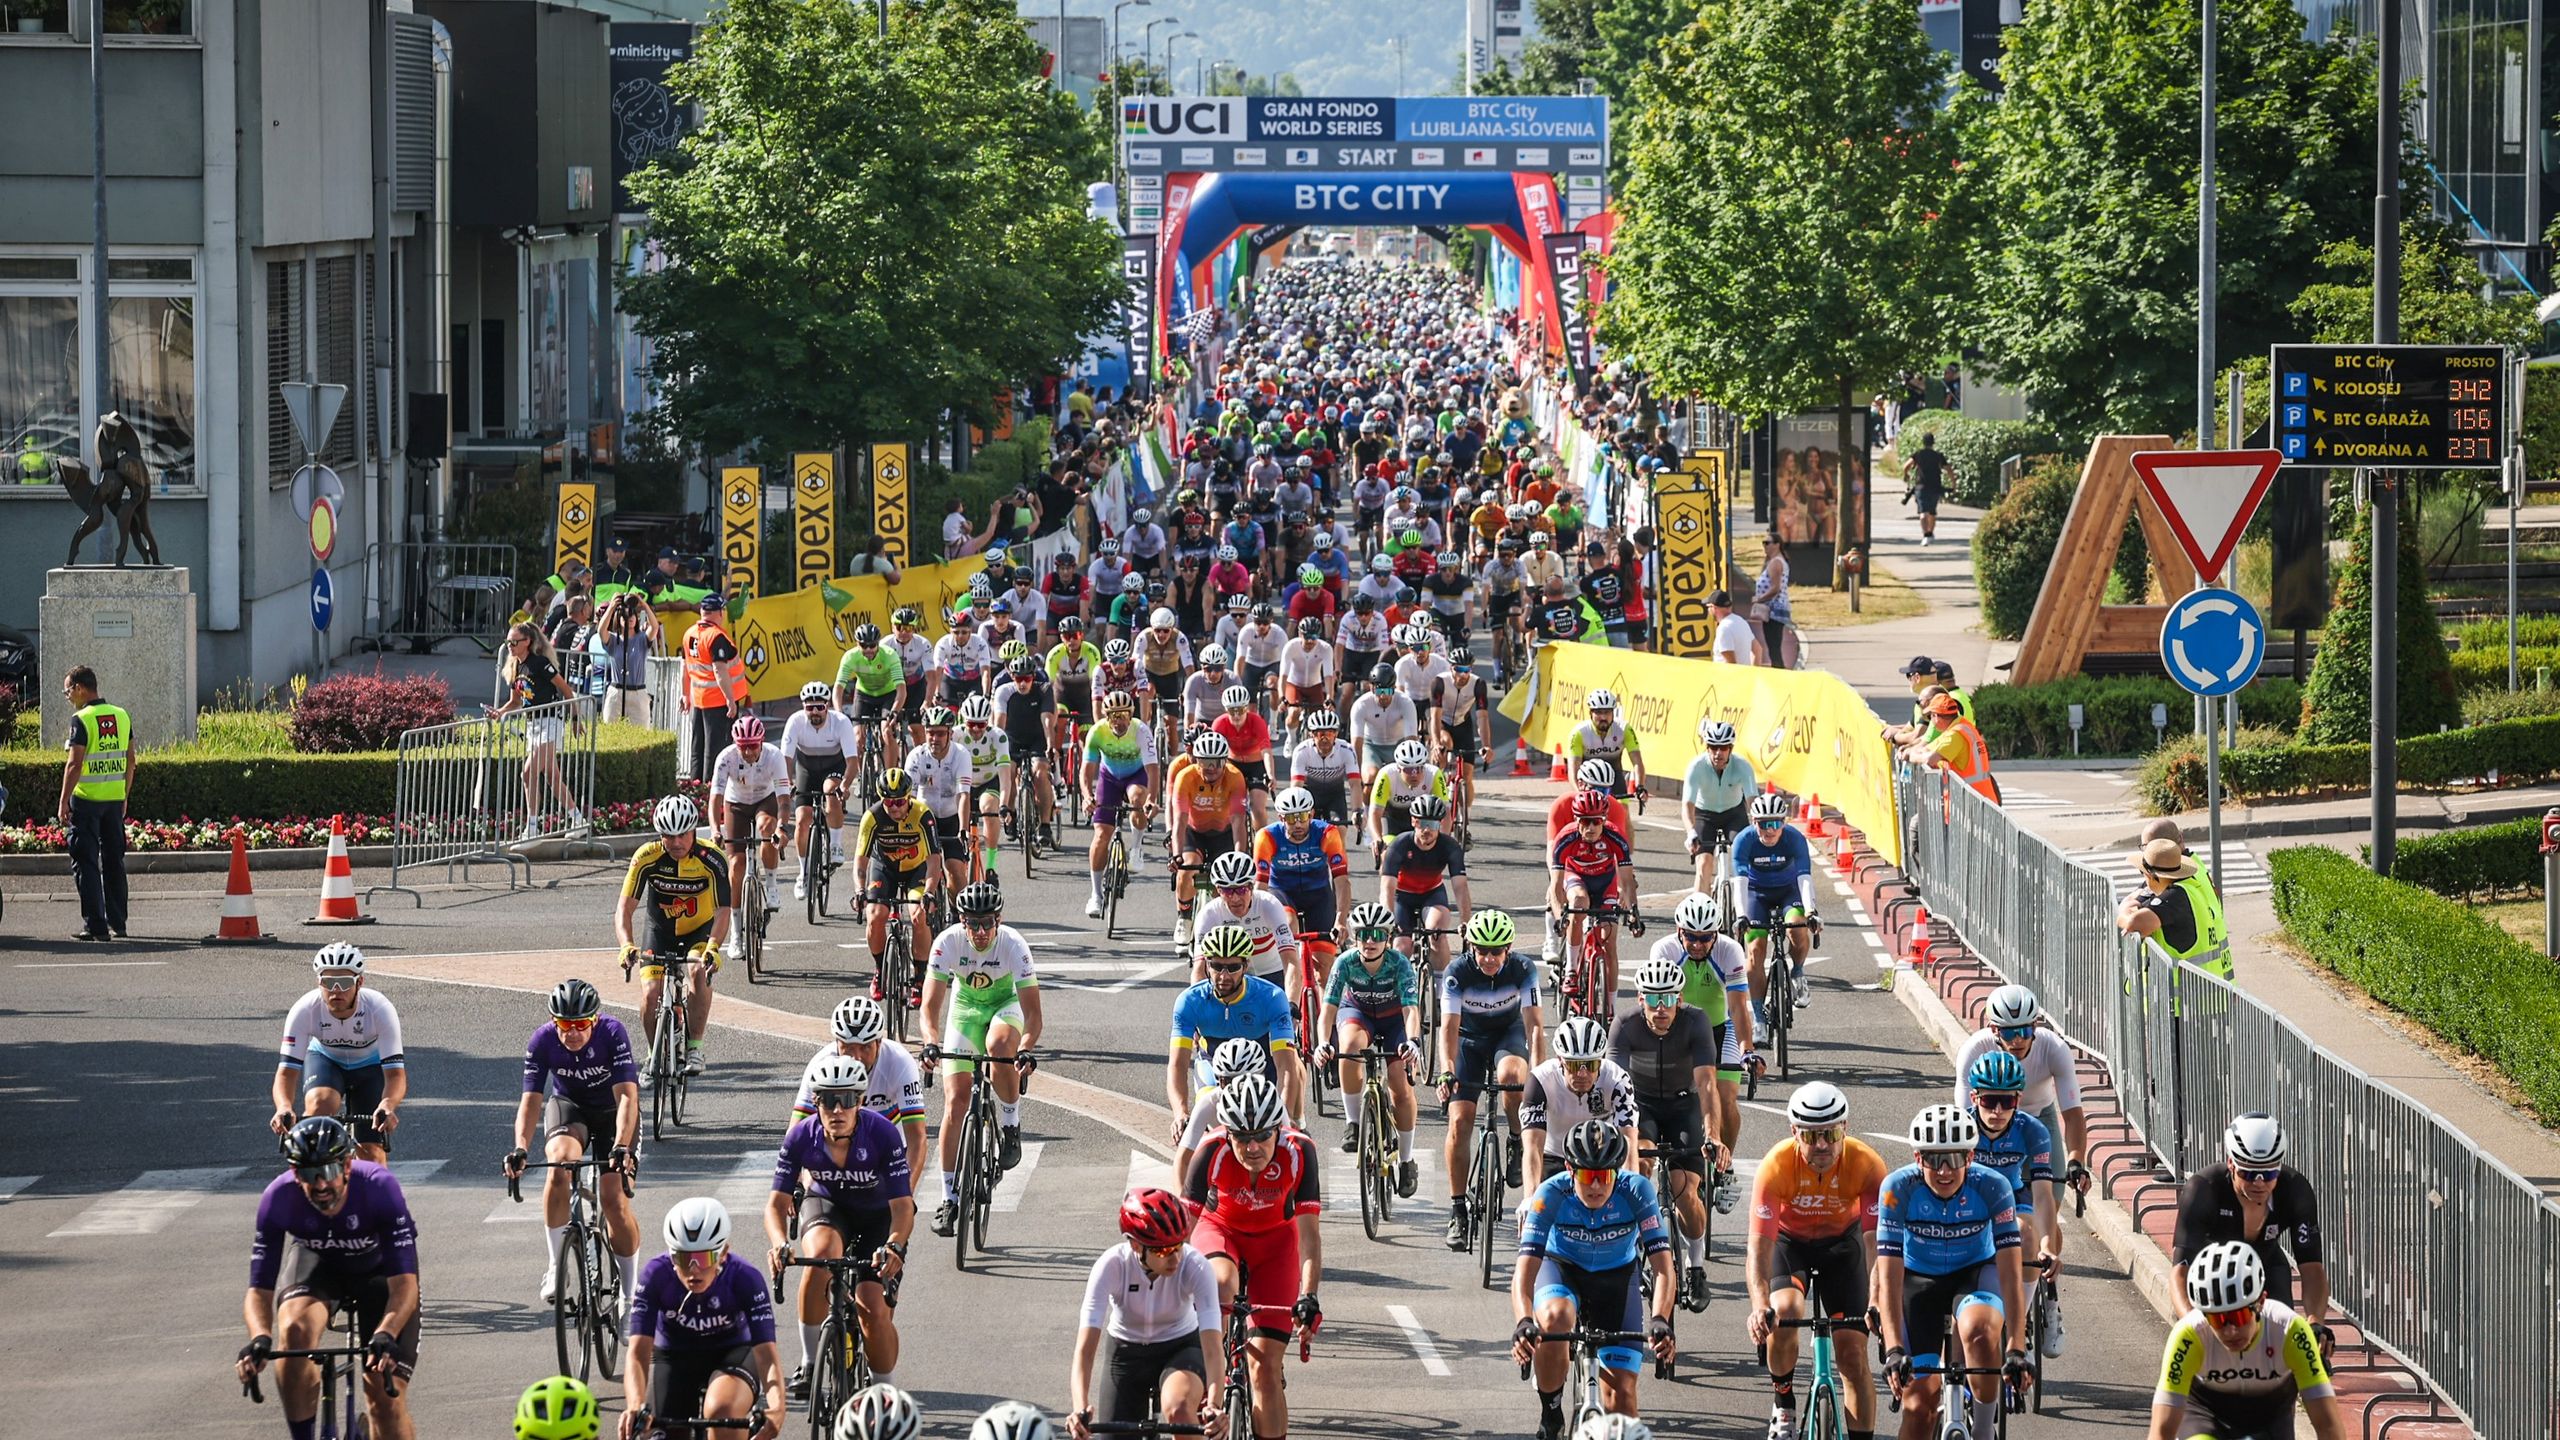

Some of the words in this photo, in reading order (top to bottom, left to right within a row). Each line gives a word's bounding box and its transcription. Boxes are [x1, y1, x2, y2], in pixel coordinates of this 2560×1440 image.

[617, 44, 670, 61] minicity
[1263, 103, 1313, 117] GRAN
[1318, 103, 1379, 117] FONDO
[1468, 103, 1500, 118] BTC
[1504, 103, 1538, 122] City
[1149, 103, 1229, 135] UCI
[1260, 121, 1322, 136] WORLD
[1326, 121, 1383, 136] SERIES
[1410, 121, 1596, 137] LJUBLJANA-SLOVENIA
[1338, 148, 1398, 166] START
[1294, 184, 1360, 210] BTC
[1371, 184, 1450, 210] CITY
[2334, 355, 2361, 368] BTC
[2366, 355, 2395, 370] City
[2445, 357, 2496, 368] PROSTO
[2334, 382, 2401, 396] KOLOSEJ
[2448, 379, 2491, 401] 342
[2333, 413, 2363, 426] BTC
[2365, 409, 2431, 426] GARAŽA
[2452, 408, 2491, 430] 156
[2333, 443, 2413, 457] DVORANA
[2416, 443, 2429, 457] A
[2448, 437, 2491, 459] 237
[99, 740, 120, 751] Sintal
[1464, 993, 1518, 1009] KOLEKTOR
[903, 1081, 922, 1097] RID
[810, 1168, 877, 1183] BRANIK
[665, 1310, 731, 1331] BRANIK
[2207, 1368, 2281, 1382] ROGLA
